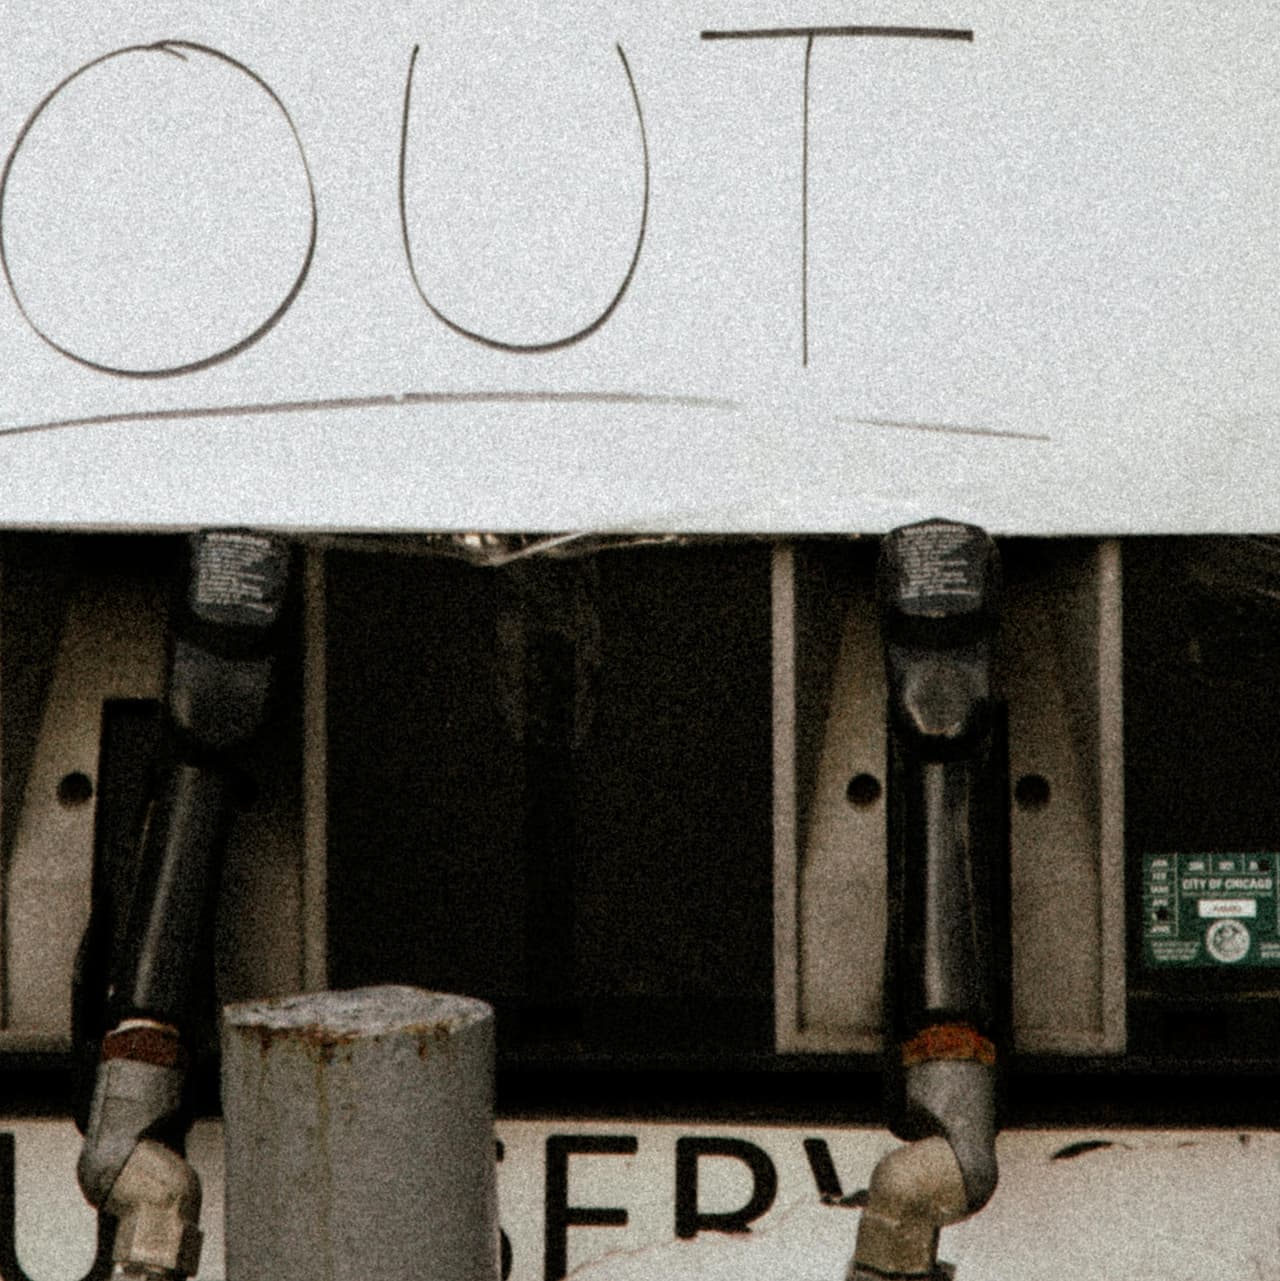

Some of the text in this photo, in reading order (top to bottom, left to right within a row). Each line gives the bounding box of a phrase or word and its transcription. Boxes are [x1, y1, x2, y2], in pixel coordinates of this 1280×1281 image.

[1181, 877, 1273, 891] CITY OF CHICAGO
